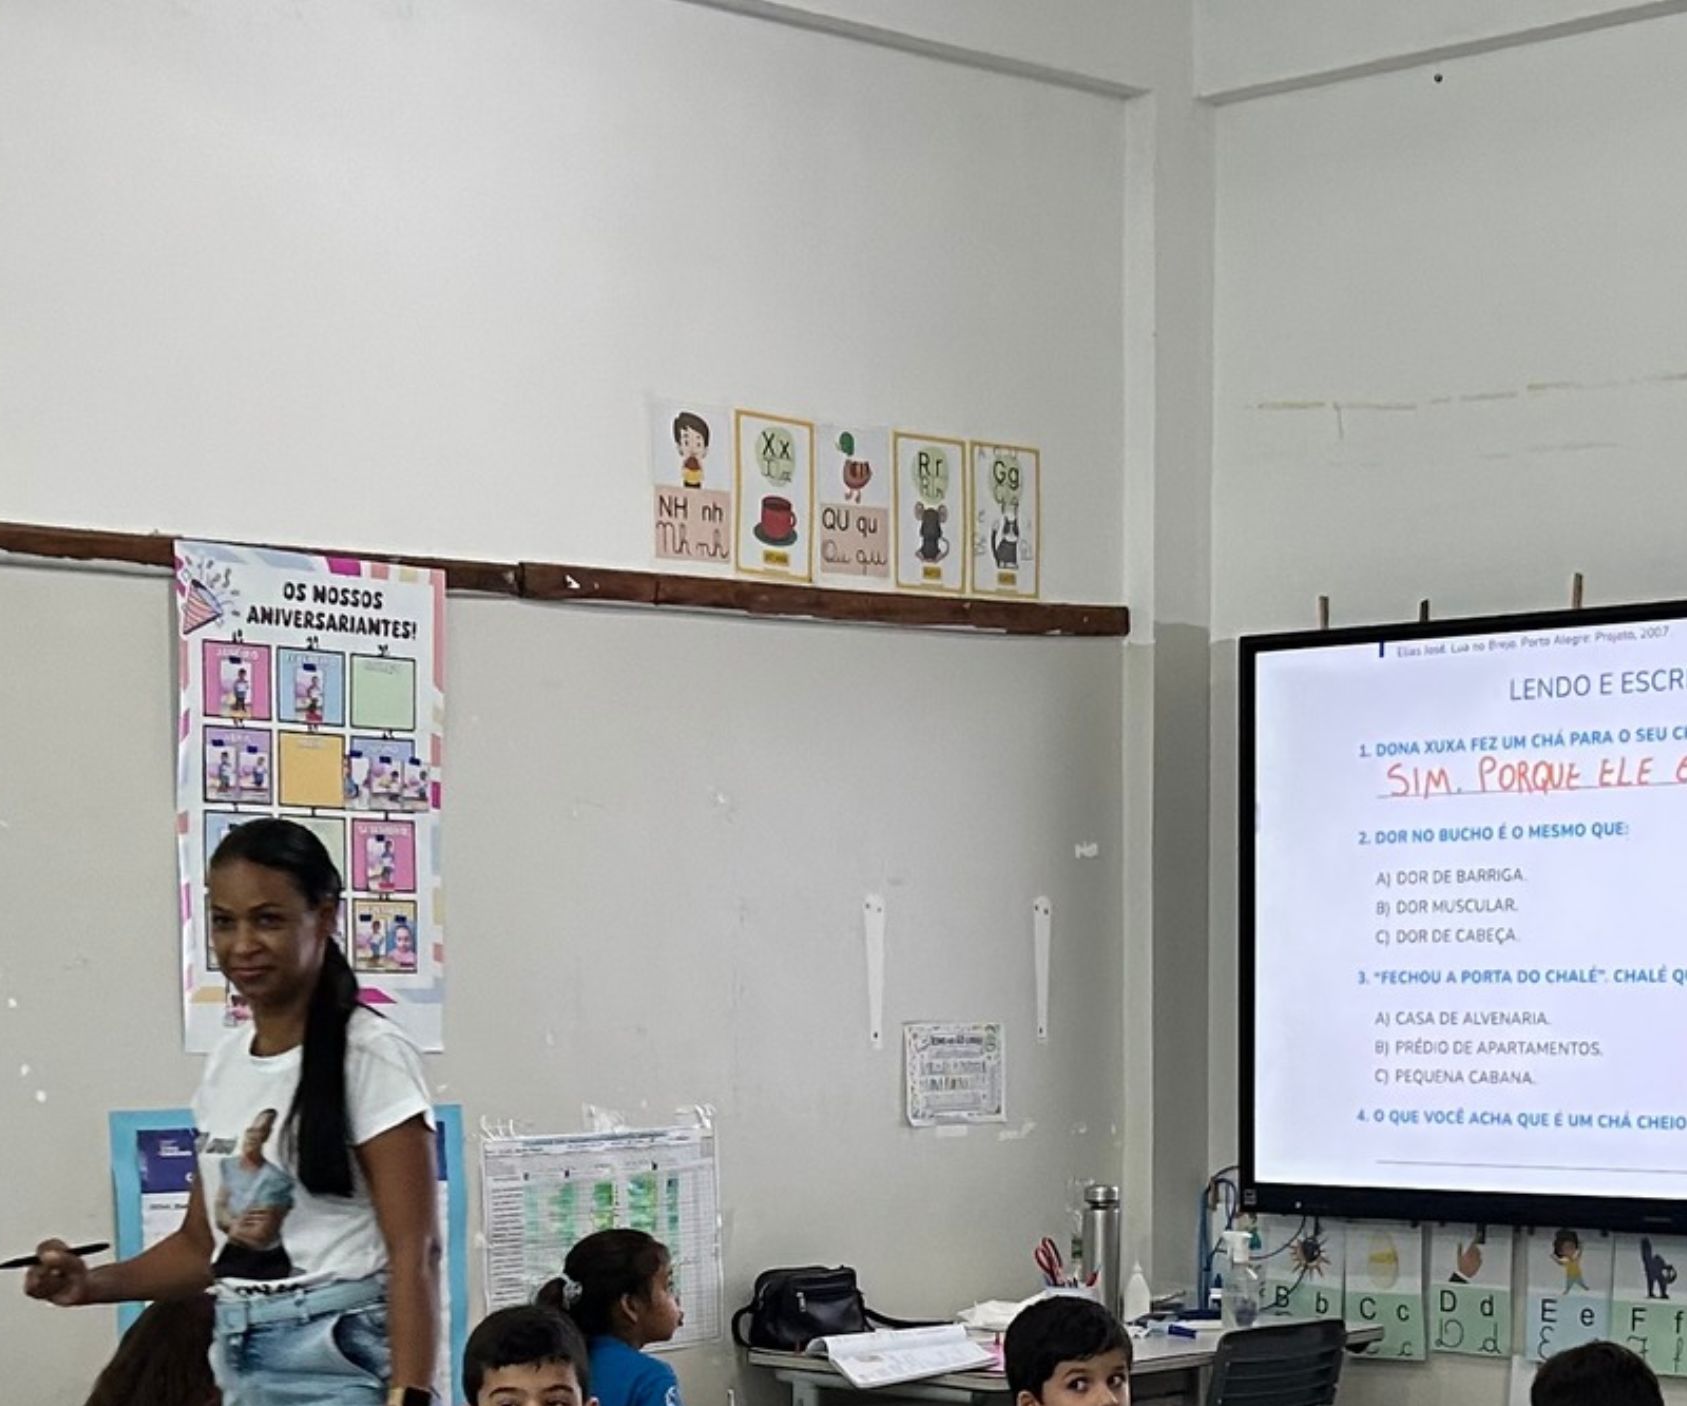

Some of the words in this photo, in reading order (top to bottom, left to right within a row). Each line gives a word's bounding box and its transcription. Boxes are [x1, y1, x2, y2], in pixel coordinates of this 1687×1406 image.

[659, 494, 688, 520] NH
[702, 502, 723, 522] nh
[821, 507, 849, 531] QU
[856, 516, 878, 538] qu
[283, 581, 307, 601] OS
[312, 584, 384, 610] NOSSOS
[246, 604, 417, 641] ANIVERSARIANTES!
[1510, 674, 1591, 701] LENDO
[1600, 672, 1613, 695] E
[1376, 740, 1420, 757] DONA
[1424, 737, 1466, 754] XUXA
[1471, 735, 1498, 752] FEZ
[1502, 734, 1526, 750] UM
[1531, 728, 1566, 748] CHÁ
[1571, 729, 1613, 746] PARA
[1619, 728, 1631, 744] O
[1636, 726, 1668, 743] SEU
[1386, 762, 1463, 799] SIM.
[1477, 755, 1581, 794] PORQUE
[1598, 756, 1654, 788] ELE
[1358, 831, 1372, 846] 2.
[1375, 829, 1408, 845] DOR
[1412, 828, 1435, 843] NO
[1439, 825, 1494, 842] BUCHO
[1499, 821, 1507, 839] É
[1512, 825, 1523, 840] O
[1529, 822, 1586, 838] MESMO
[1592, 820, 1629, 838] QUE:
[1375, 871, 1391, 887] A)
[1396, 870, 1428, 885] DOR
[1432, 869, 1452, 884] DE
[1457, 867, 1527, 883] BARRIGA.
[1376, 901, 1390, 917] B)
[1396, 900, 1428, 915] DOR
[1432, 898, 1519, 913] MUSCULAR.
[1375, 930, 1390, 946] C)
[1396, 929, 1428, 944] DOR
[1432, 929, 1451, 943] DE
[1456, 927, 1520, 945] CABEÇA.
[1358, 971, 1370, 985] 3.
[1446, 970, 1458, 984] A
[1461, 969, 1512, 984] PORTA
[1517, 970, 1540, 984] DO
[1613, 964, 1667, 984] CHALÉ
[1375, 1012, 1390, 1027] A)
[1395, 1011, 1435, 1025] CASA
[1439, 1011, 1458, 1025] DE
[1463, 1011, 1551, 1026] ALVENARIA.
[1375, 1040, 1389, 1056] B)
[1395, 1036, 1449, 1055] PRÉDIO
[1453, 1041, 1472, 1055] DE
[1477, 1041, 1603, 1056] APARTAMENTOS.
[1375, 1068, 1389, 1084] C)
[1395, 1069, 1464, 1086] PEQUENA
[1469, 1070, 1536, 1085] CABANA.
[1357, 1108, 1370, 1122] 4.
[1373, 1109, 1385, 1123] O
[1389, 1110, 1419, 1125] QUE
[1424, 1106, 1465, 1124] VOCÊ
[1469, 1111, 1512, 1126] ACHA
[1517, 1112, 1549, 1128] QUE
[1554, 1108, 1563, 1127] É
[1568, 1113, 1593, 1128] UM
[1598, 1109, 1632, 1129] CHÁ
[1637, 1115, 1687, 1130] CHEIO
[1439, 1290, 1458, 1313] D
[1479, 1294, 1495, 1317] d
[1631, 1307, 1647, 1332] F
[1674, 1311, 1684, 1333] f
